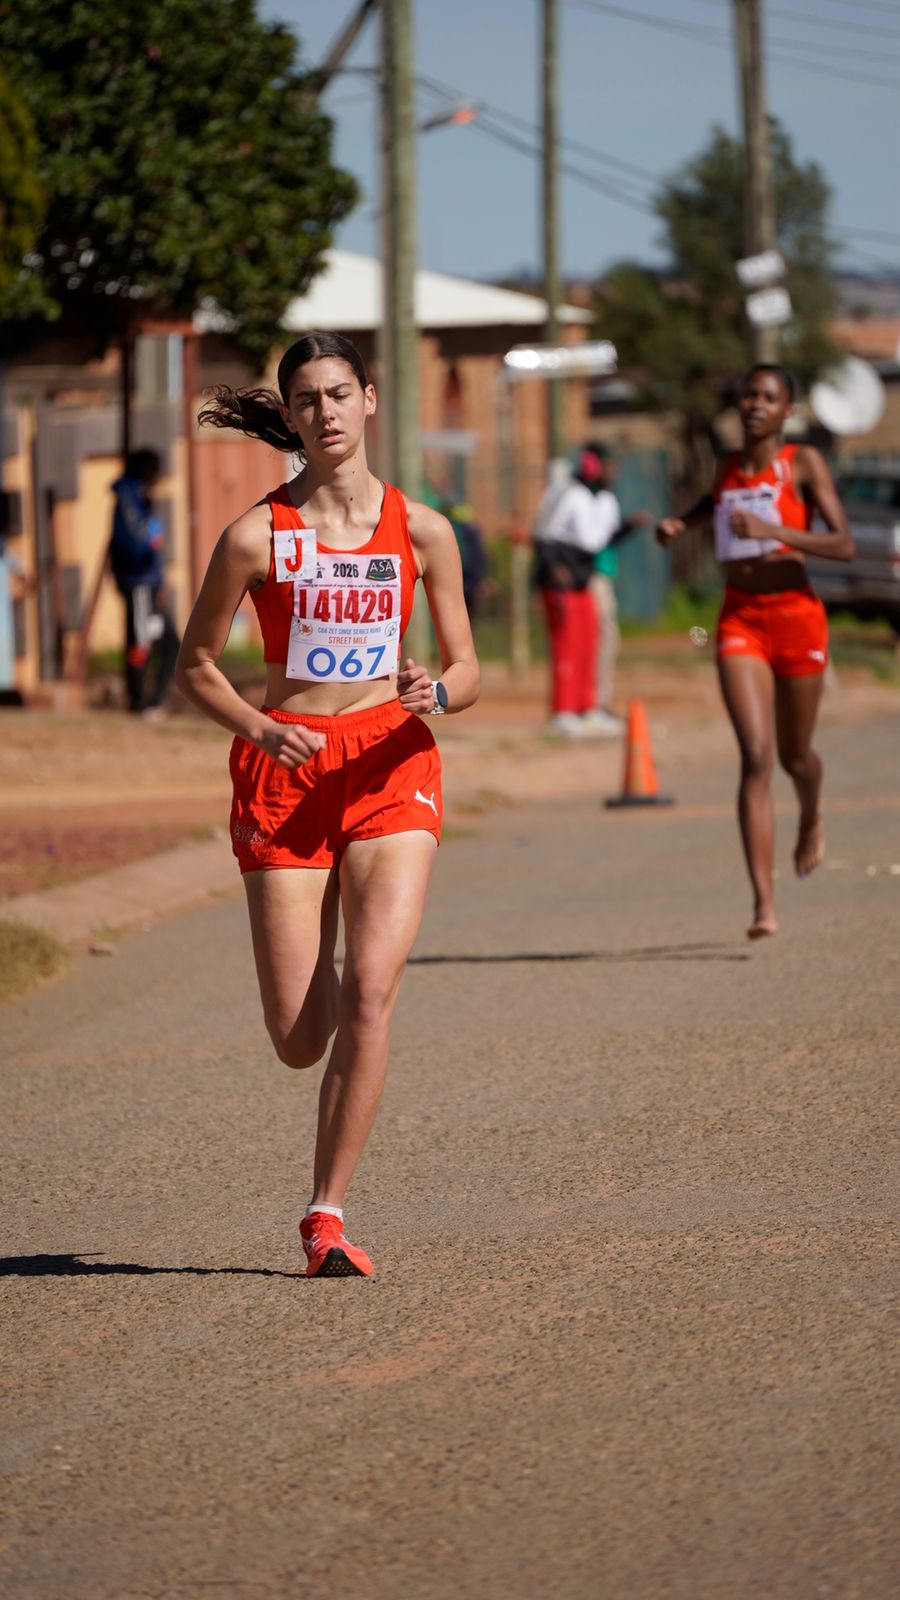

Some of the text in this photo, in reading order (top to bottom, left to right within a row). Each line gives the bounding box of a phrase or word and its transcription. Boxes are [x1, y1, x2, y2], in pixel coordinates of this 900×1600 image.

[284, 537, 303, 572] J
[333, 563, 359, 578] 2026
[370, 562, 393, 572] ASA
[328, 636, 368, 645] STREET MILE
[306, 645, 386, 678] 067
